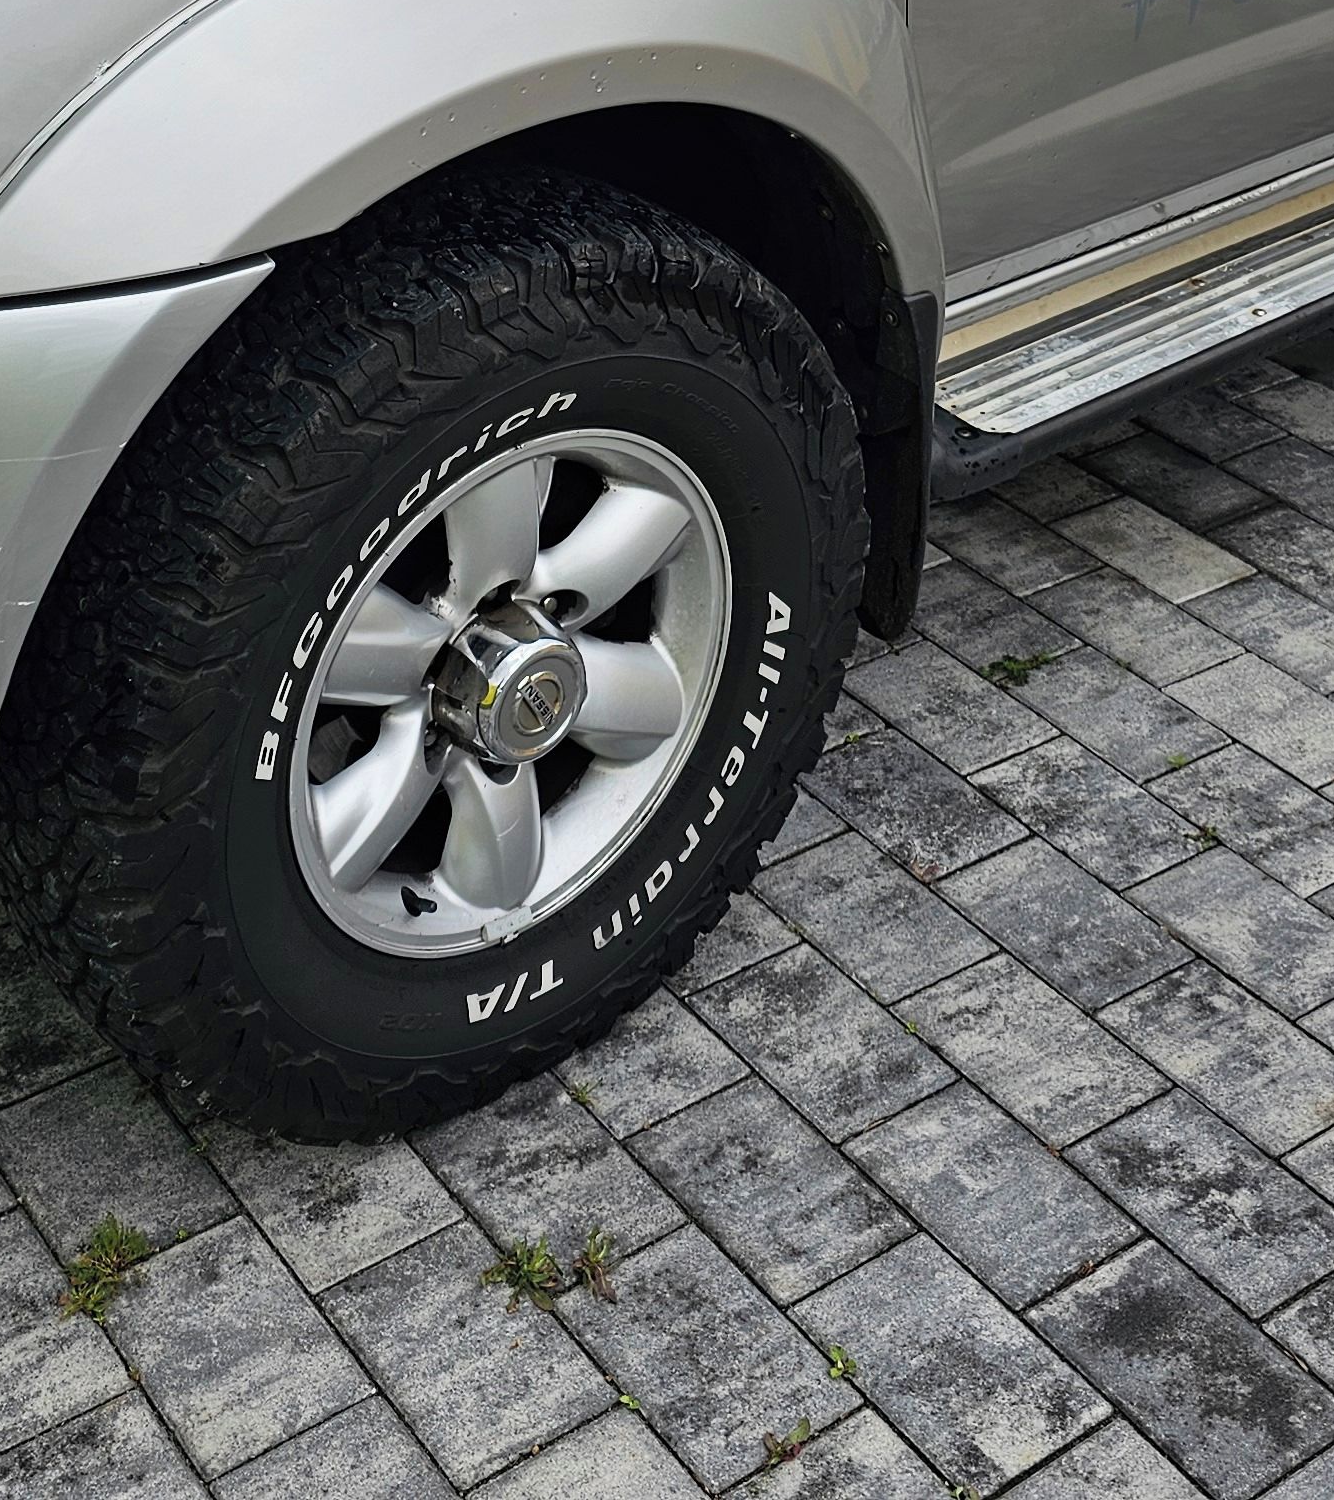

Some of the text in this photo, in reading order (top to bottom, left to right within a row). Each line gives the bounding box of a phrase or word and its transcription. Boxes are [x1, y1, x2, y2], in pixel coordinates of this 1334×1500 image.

[255, 391, 577, 781] BFGoodrich
[525, 684, 555, 726] NISSAN
[592, 591, 792, 950] All-Terrain
[467, 959, 564, 1024] T/A
